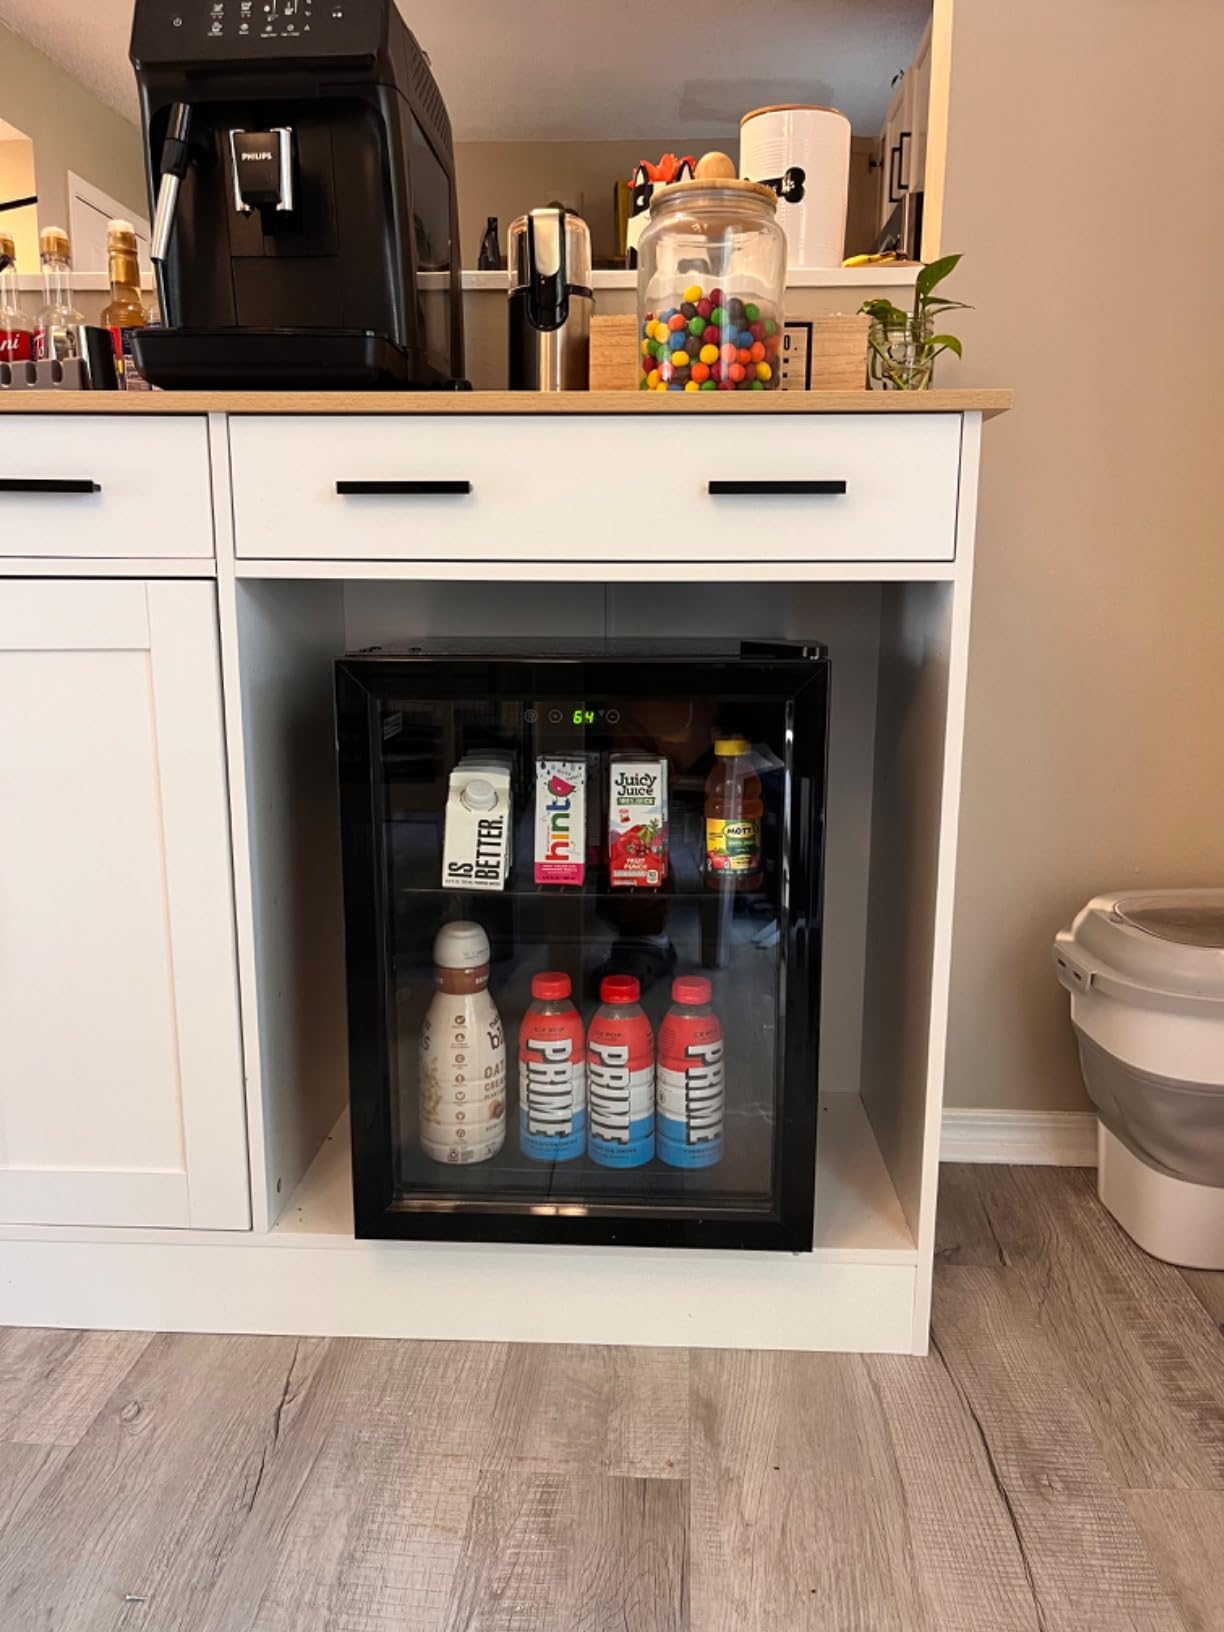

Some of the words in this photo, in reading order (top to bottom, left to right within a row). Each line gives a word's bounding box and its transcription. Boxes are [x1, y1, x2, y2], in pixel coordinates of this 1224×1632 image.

[572, 710, 595, 724] 64
[615, 772, 657, 788] Juicy
[617, 786, 654, 796] Juice
[475, 815, 503, 879] BETTER.
[545, 798, 571, 860] hint
[448, 861, 473, 878] IS
[527, 1039, 573, 1138] PRIME
[589, 1041, 630, 1145] PRIME
[685, 1039, 724, 1145] PRIME
